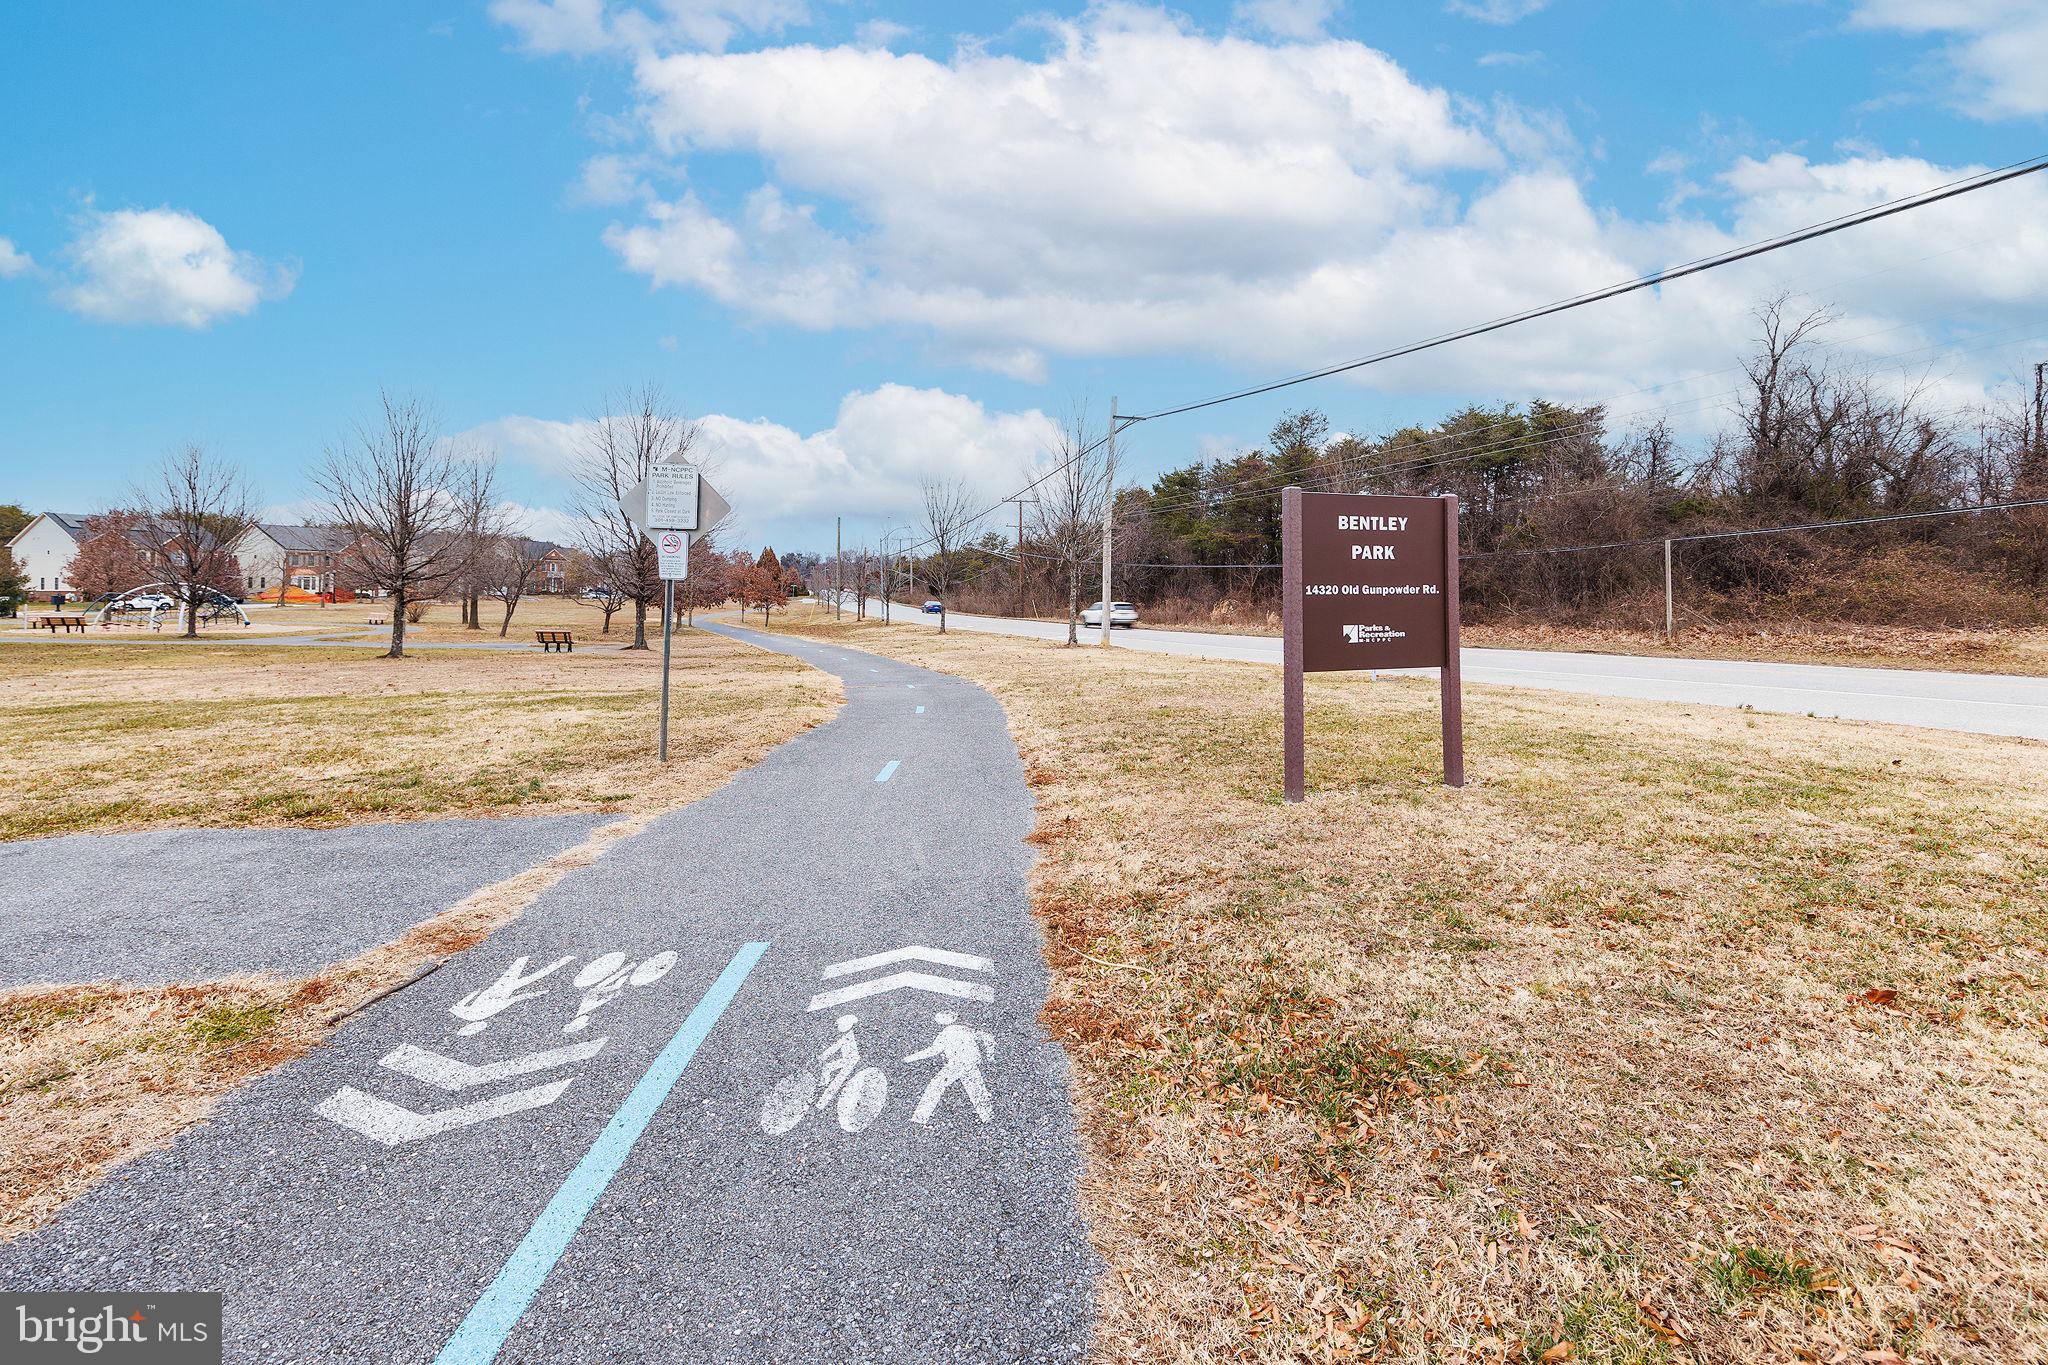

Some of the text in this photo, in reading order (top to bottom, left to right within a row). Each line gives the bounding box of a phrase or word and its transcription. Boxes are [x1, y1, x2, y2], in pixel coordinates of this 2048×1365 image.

[1338, 516, 1408, 530] BENTLEY
[1352, 546, 1395, 560] PARK
[1306, 584, 1440, 596] 14320 Old Gunpowder Rd.
